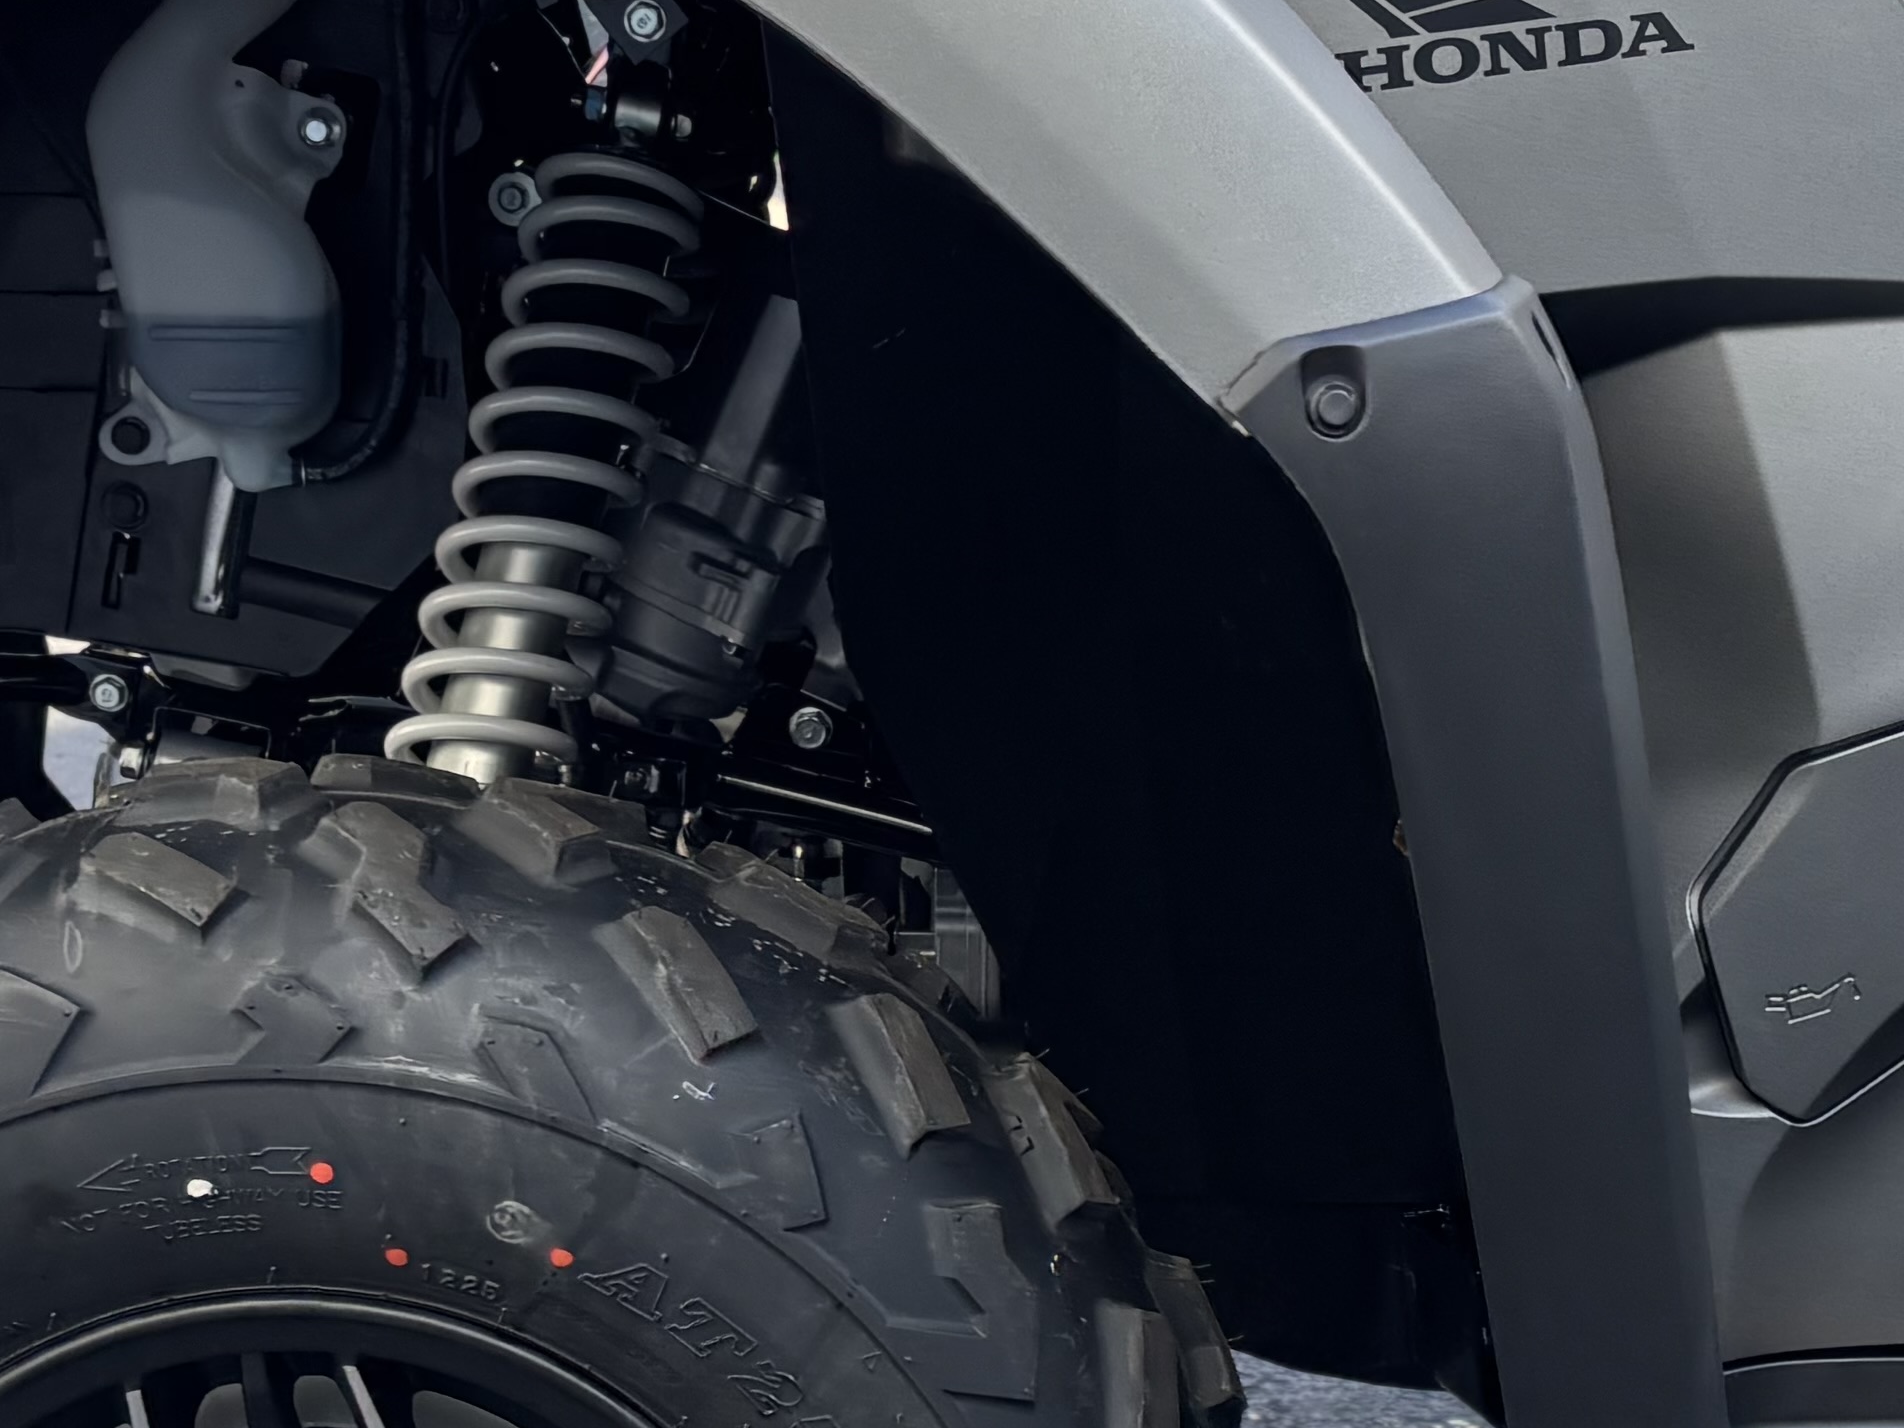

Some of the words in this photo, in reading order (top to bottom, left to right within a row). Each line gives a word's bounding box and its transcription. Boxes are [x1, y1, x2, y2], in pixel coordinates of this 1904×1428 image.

[1335, 12, 1695, 94] HONDA
[119, 1196, 171, 1221] FOR
[180, 1184, 284, 1213] HGHWAY
[296, 1189, 344, 1211] USE
[141, 1212, 264, 1242] TUBELESS
[419, 1261, 502, 1302] 1225
